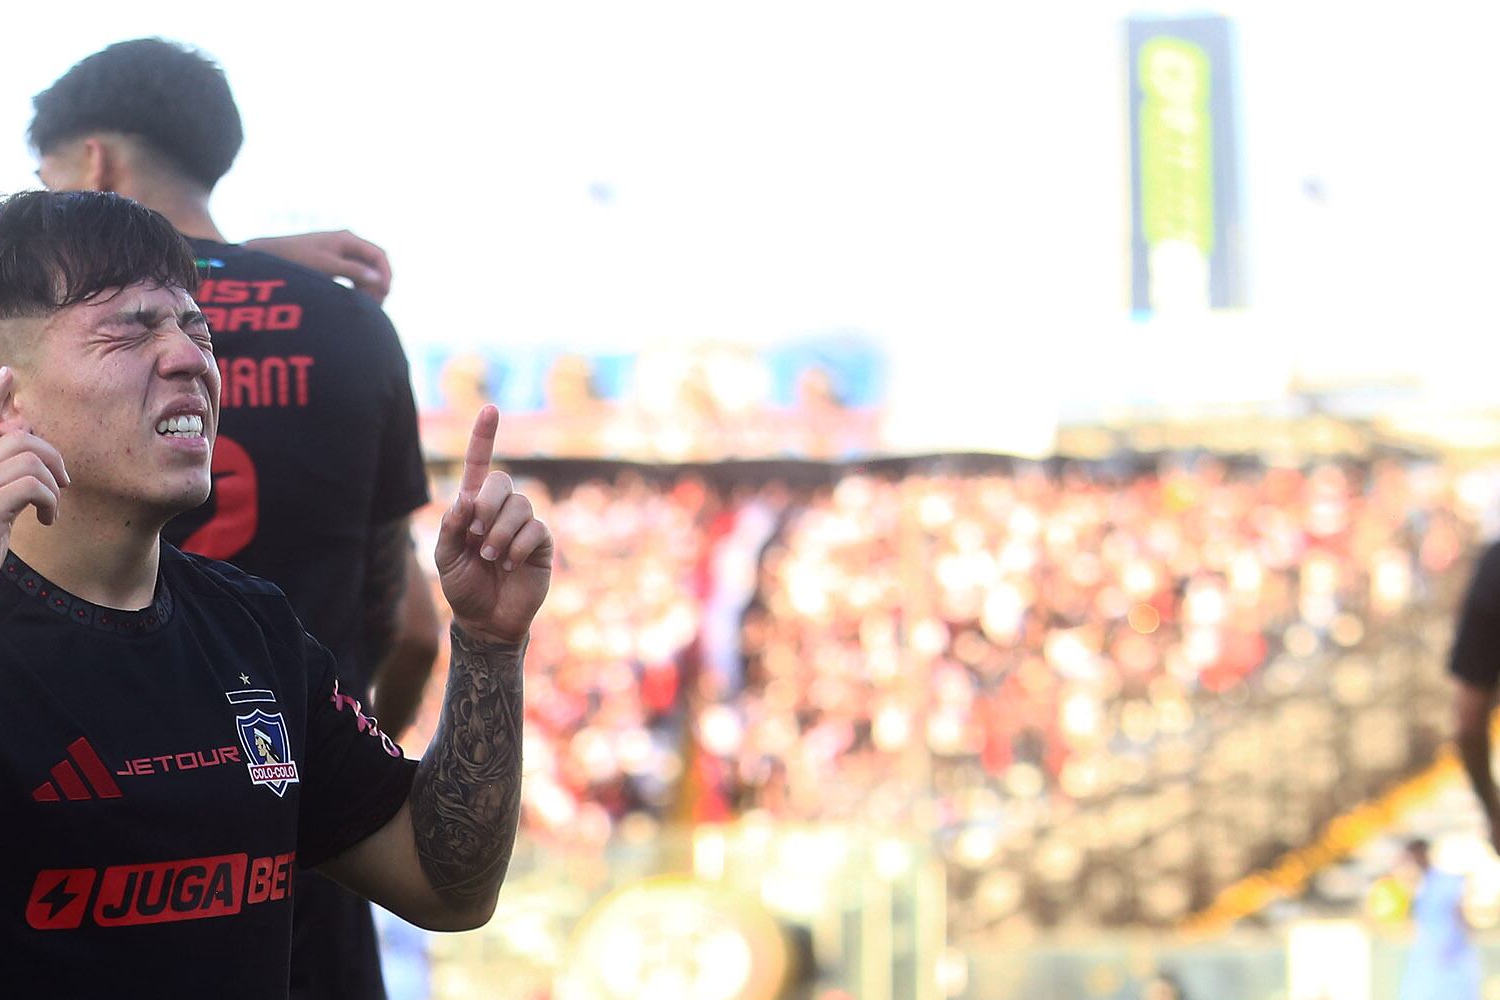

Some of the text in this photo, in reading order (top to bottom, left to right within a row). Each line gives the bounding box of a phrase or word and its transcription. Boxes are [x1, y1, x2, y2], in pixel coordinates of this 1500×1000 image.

[207, 303, 303, 332] ARD
[116, 745, 241, 776] JETOUR
[252, 765, 295, 780] COLO-COLO
